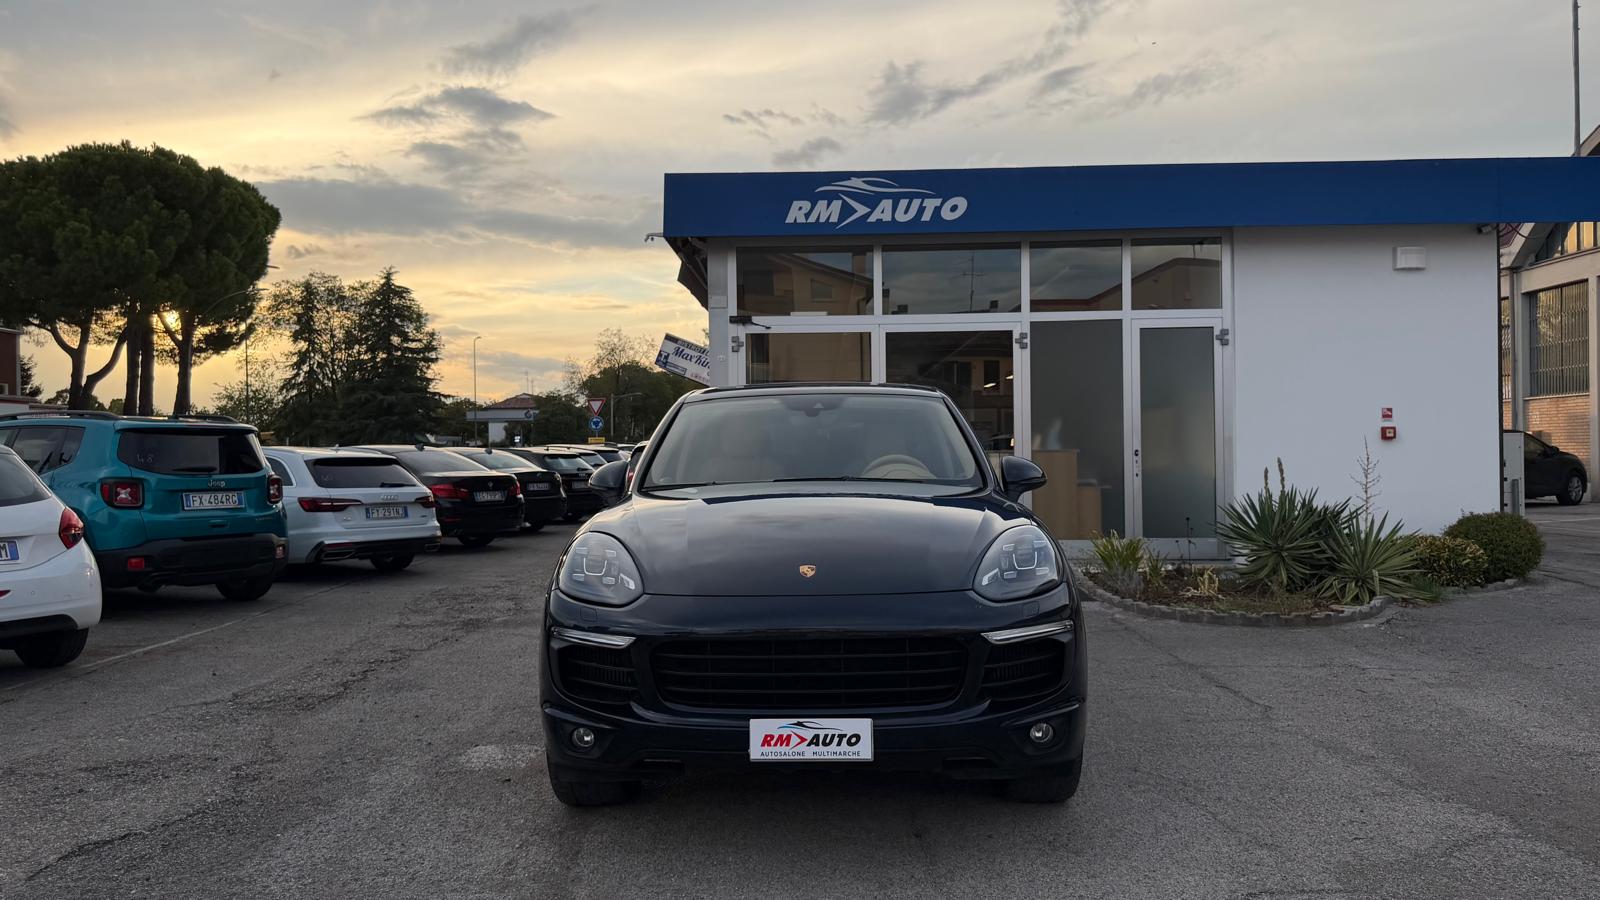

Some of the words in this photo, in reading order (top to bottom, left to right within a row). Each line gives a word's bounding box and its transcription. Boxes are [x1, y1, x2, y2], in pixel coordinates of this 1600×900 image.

[785, 200, 842, 223] RM
[866, 196, 968, 223] AUTO
[208, 479, 226, 488] Jeep
[760, 733, 793, 747] RM
[806, 733, 861, 747] AUTO
